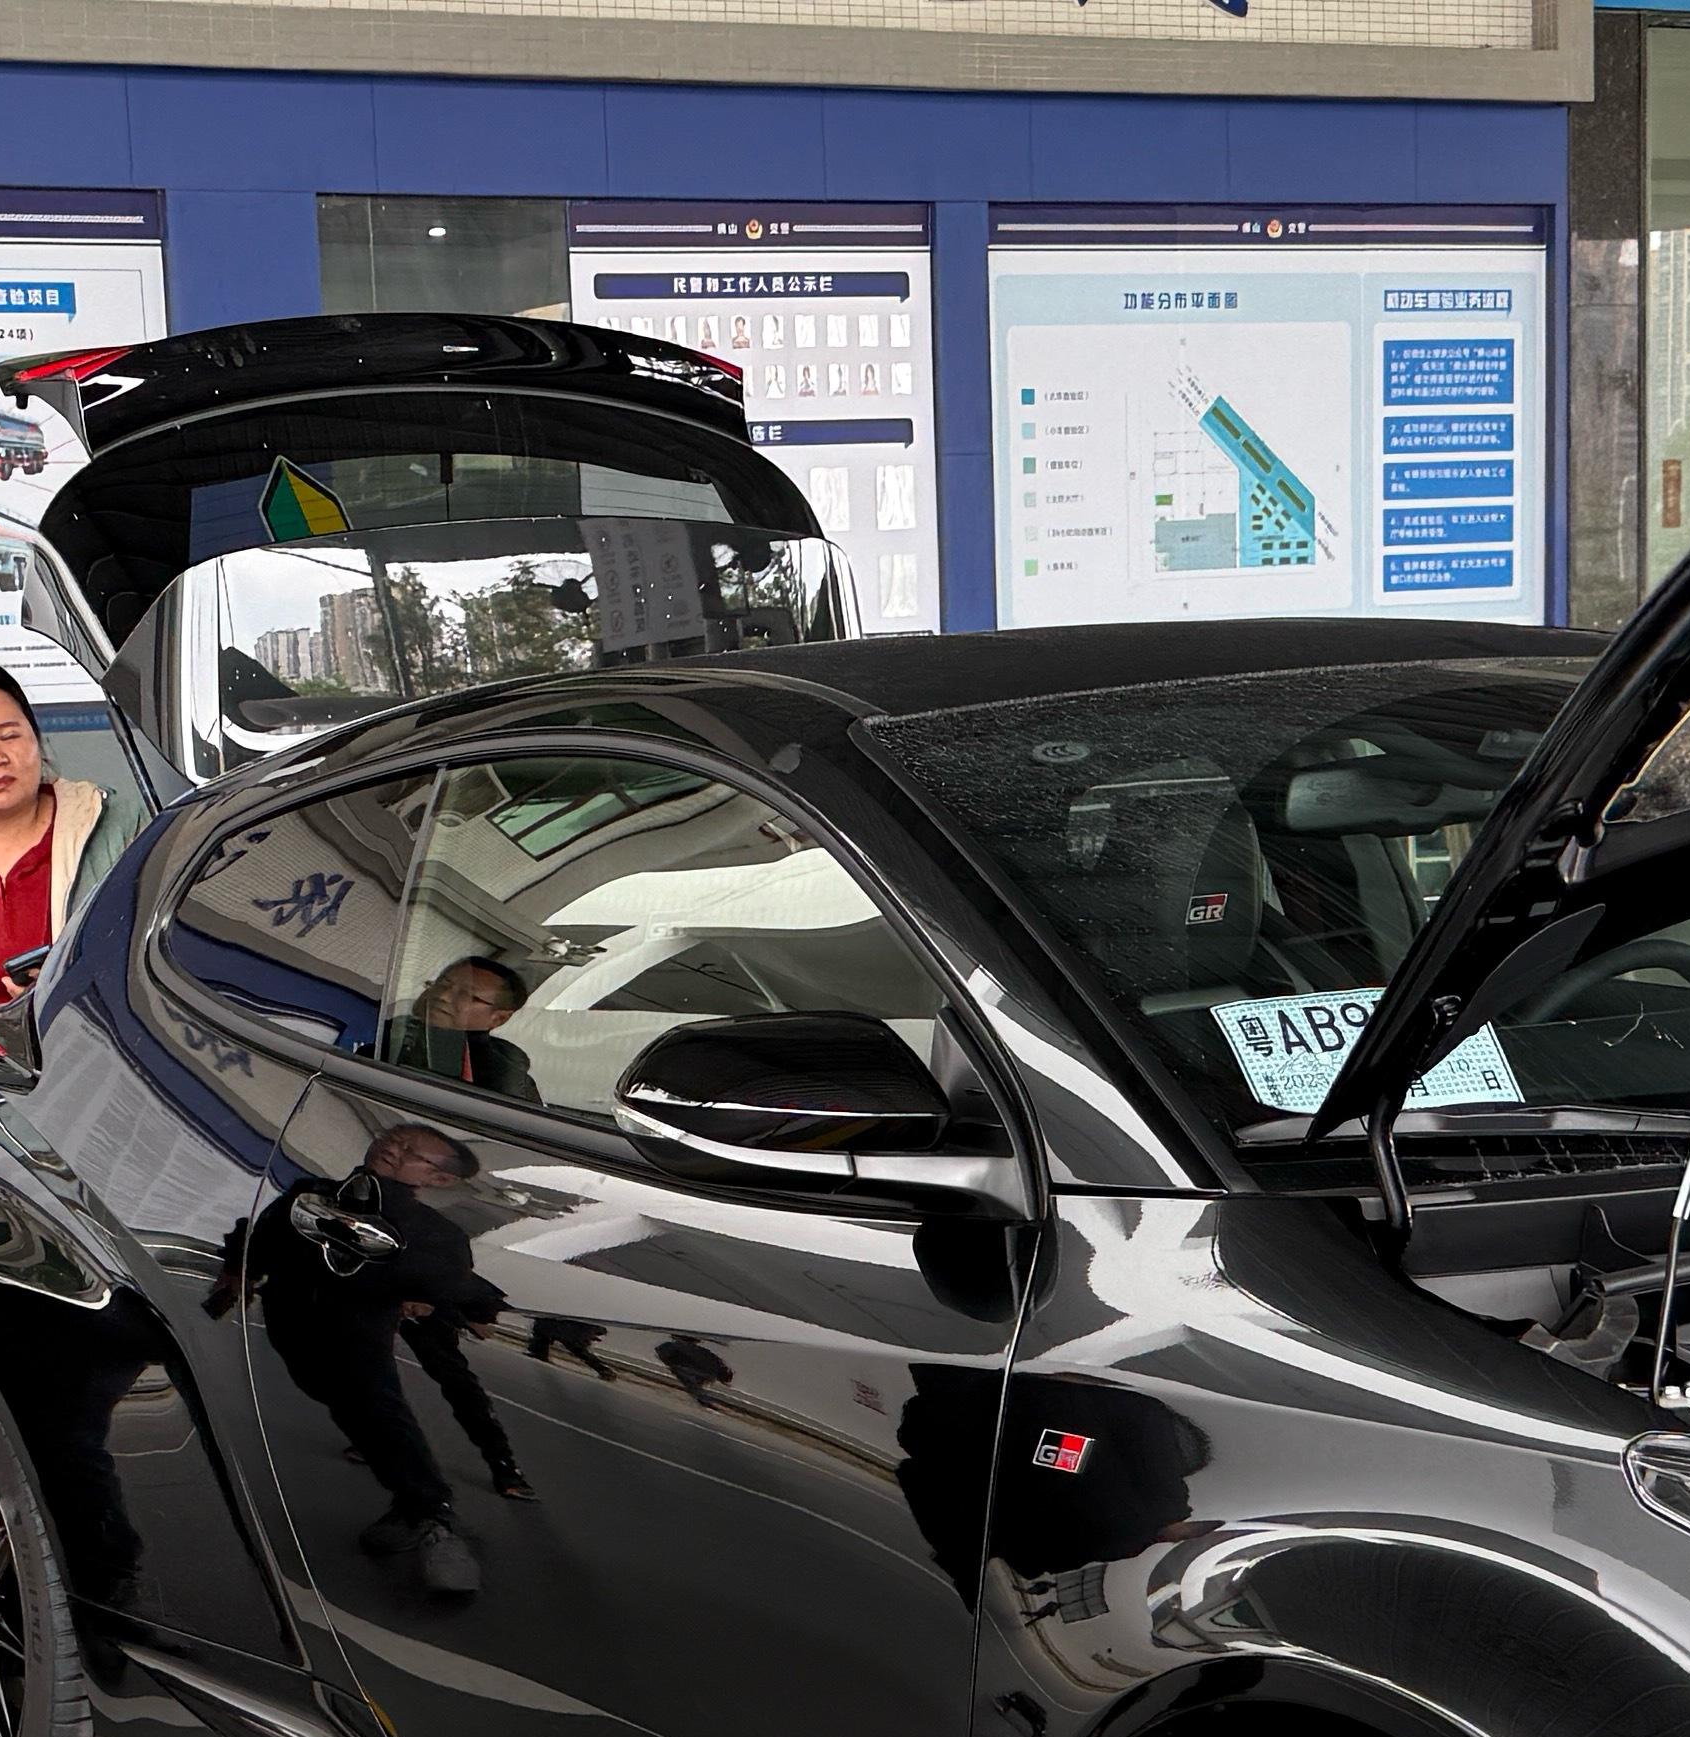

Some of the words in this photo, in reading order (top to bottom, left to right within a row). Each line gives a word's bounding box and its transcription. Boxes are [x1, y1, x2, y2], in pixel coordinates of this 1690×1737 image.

[1123, 292, 1239, 310] 功能分布平面图
